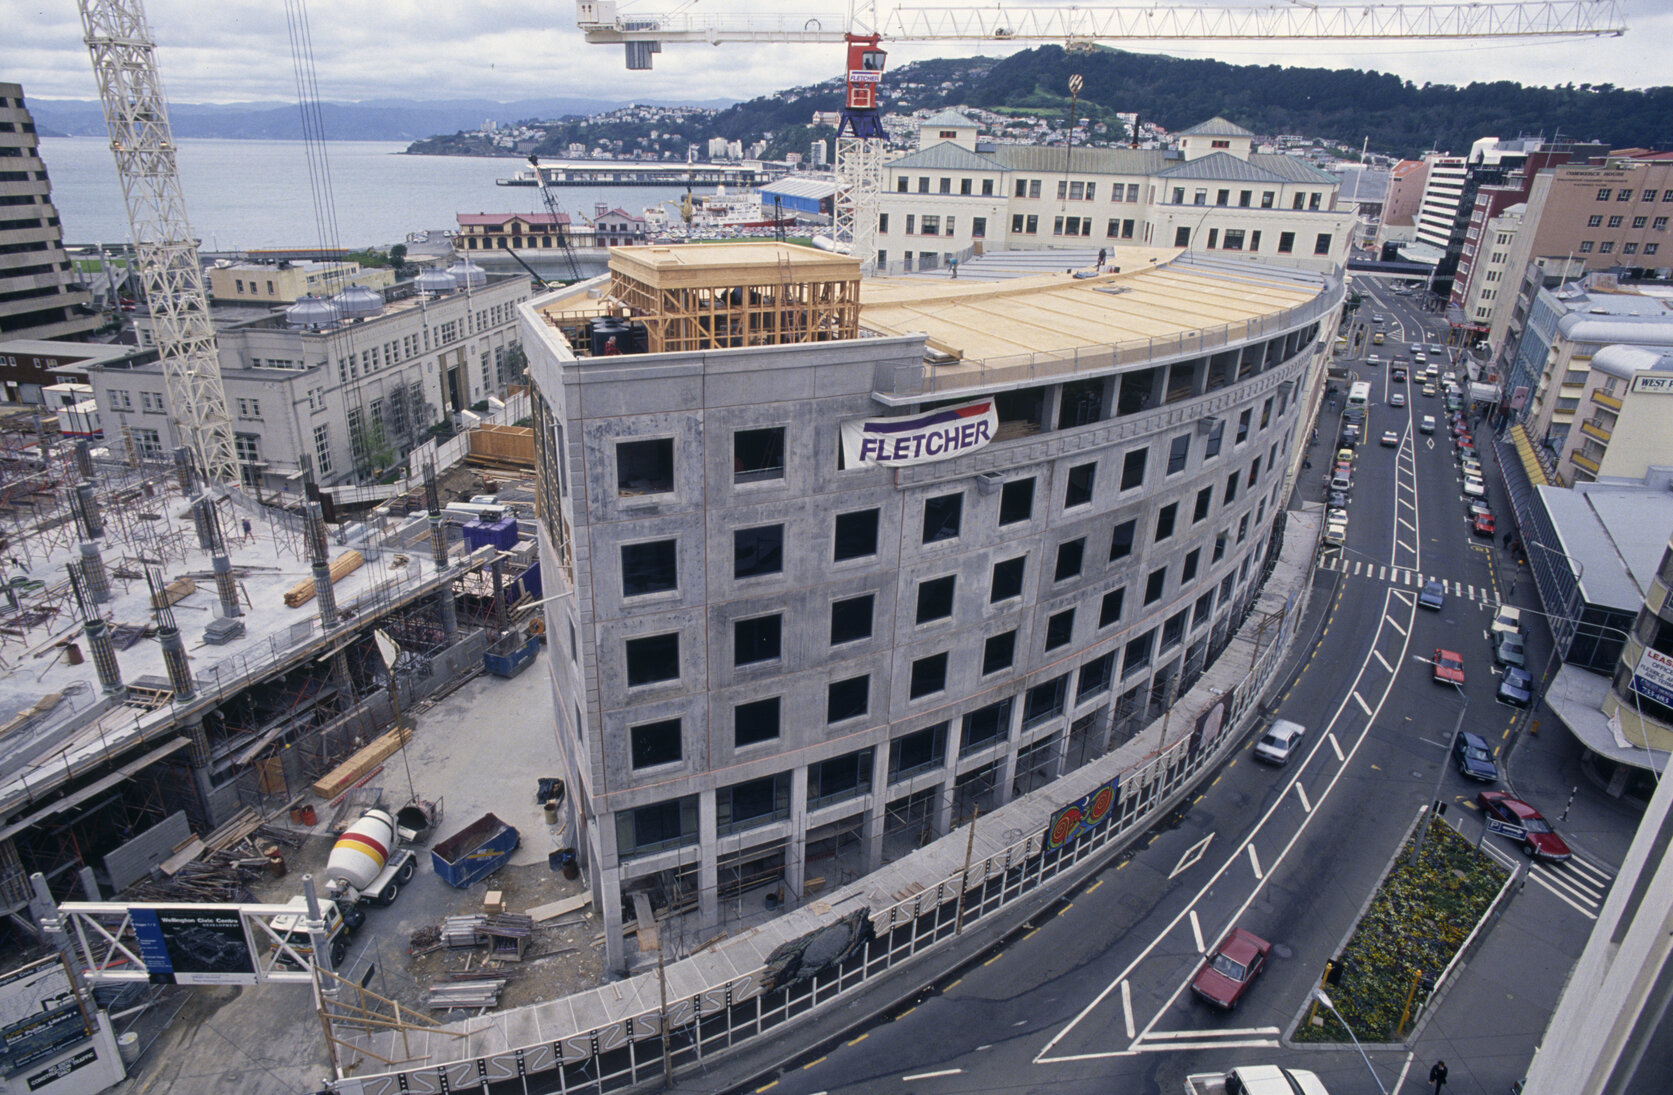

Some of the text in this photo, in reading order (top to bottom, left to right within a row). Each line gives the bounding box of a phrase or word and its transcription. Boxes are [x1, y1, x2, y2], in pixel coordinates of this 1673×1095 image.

[1641, 378, 1667, 387] WEST
[859, 419, 991, 462] FLETCHER
[1647, 650, 1673, 669] LEAS
[48, 1013, 72, 1026] Library
